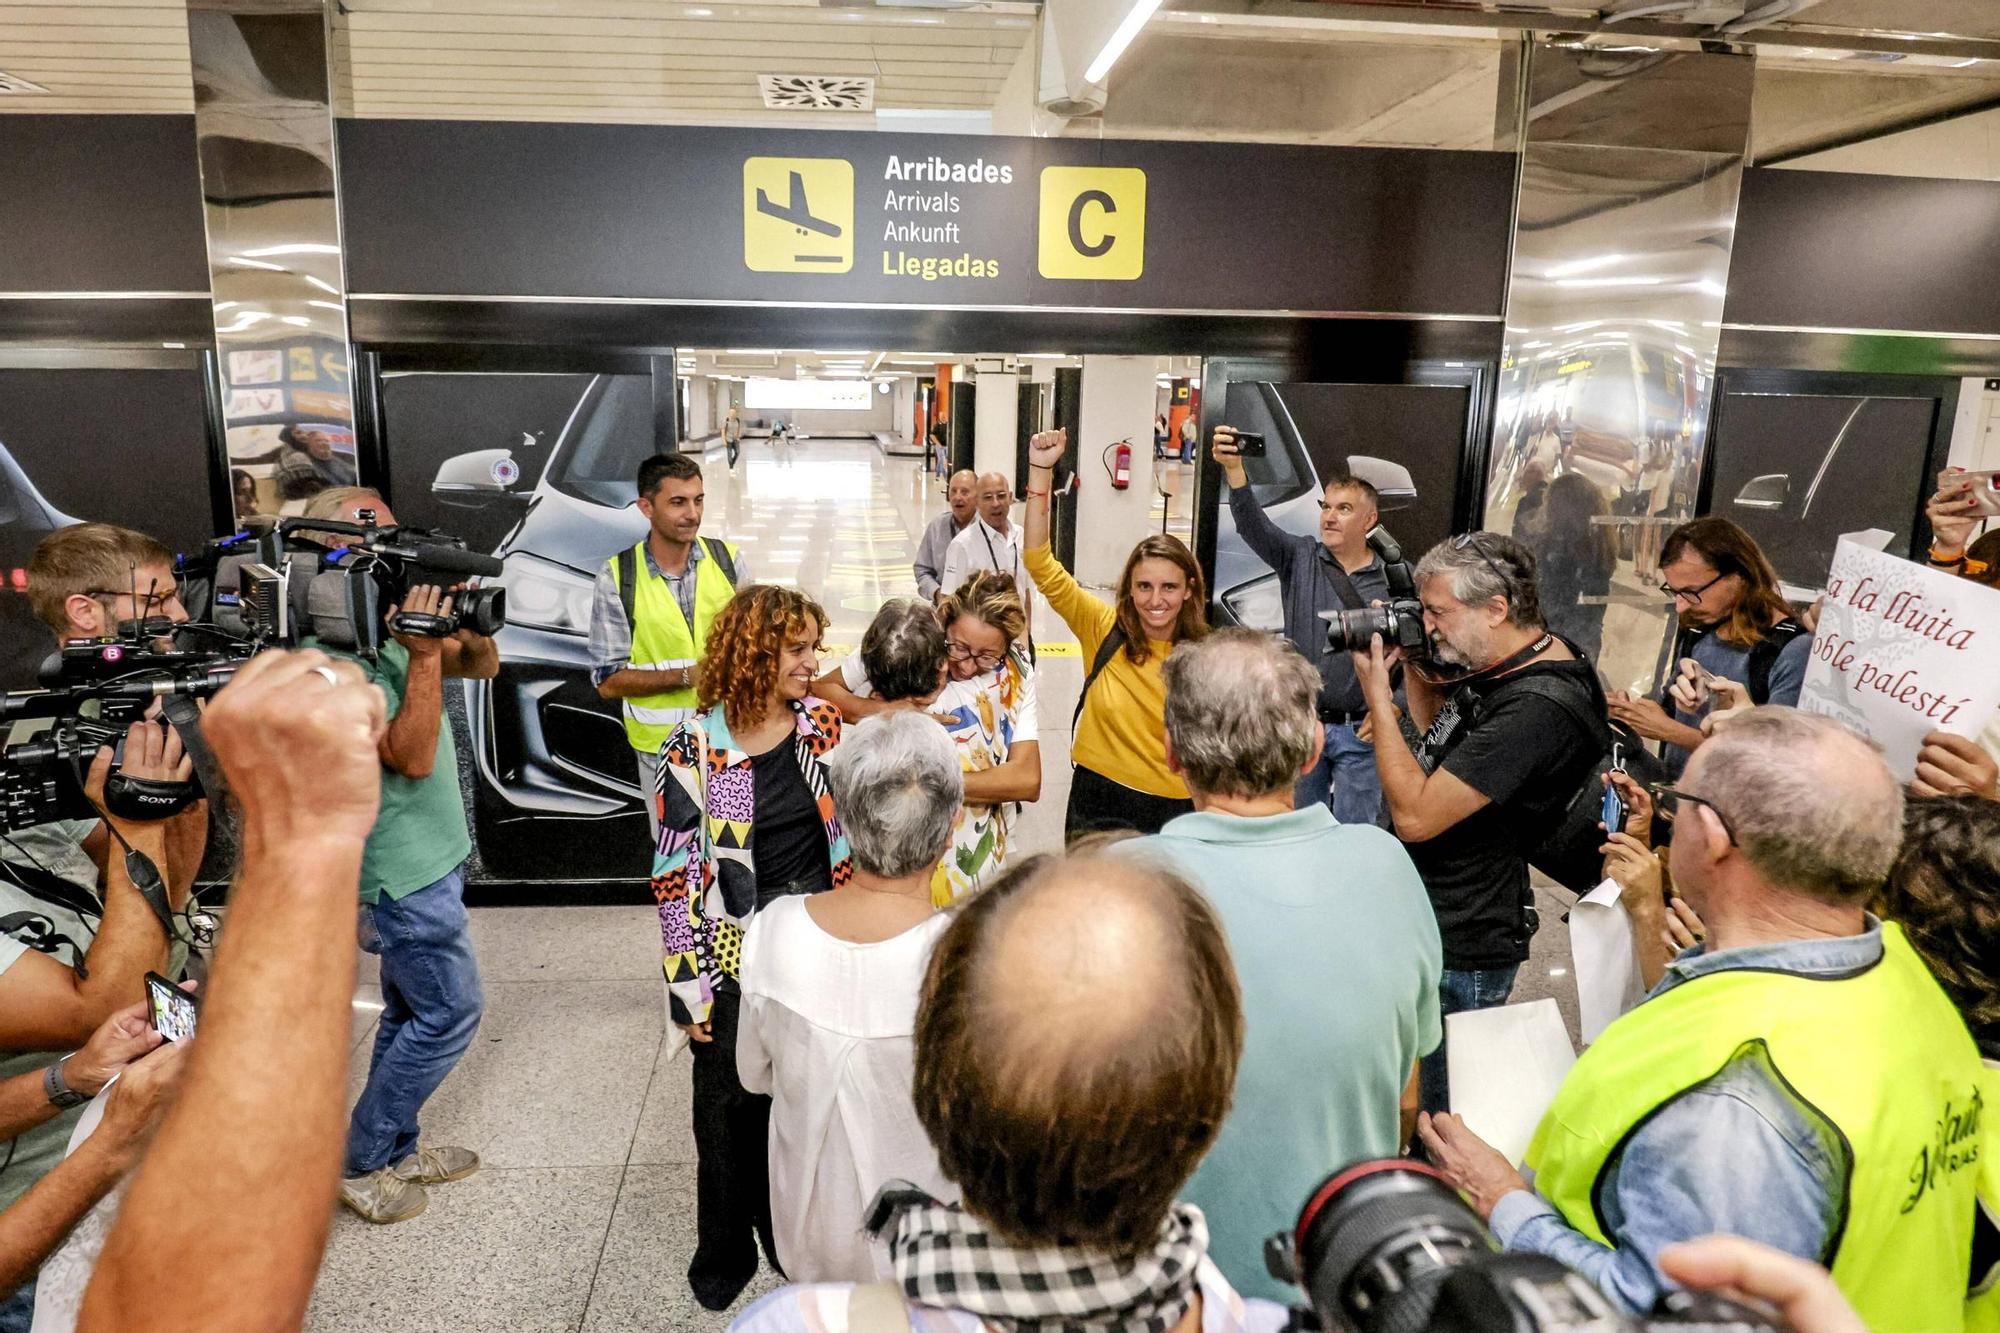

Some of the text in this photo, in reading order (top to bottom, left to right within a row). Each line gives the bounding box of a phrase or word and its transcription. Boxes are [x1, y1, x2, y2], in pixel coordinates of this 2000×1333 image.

[884, 155, 1014, 185] Arribades
[884, 189, 961, 213] Arrivals
[884, 220, 960, 244] Ankunft
[1067, 189, 1117, 258] C
[882, 250, 999, 281] Llegadas
[1848, 577, 1880, 612] la
[1883, 591, 1976, 651] lluita
[1854, 663, 1974, 725] palestí
[137, 795, 178, 805] SONY
